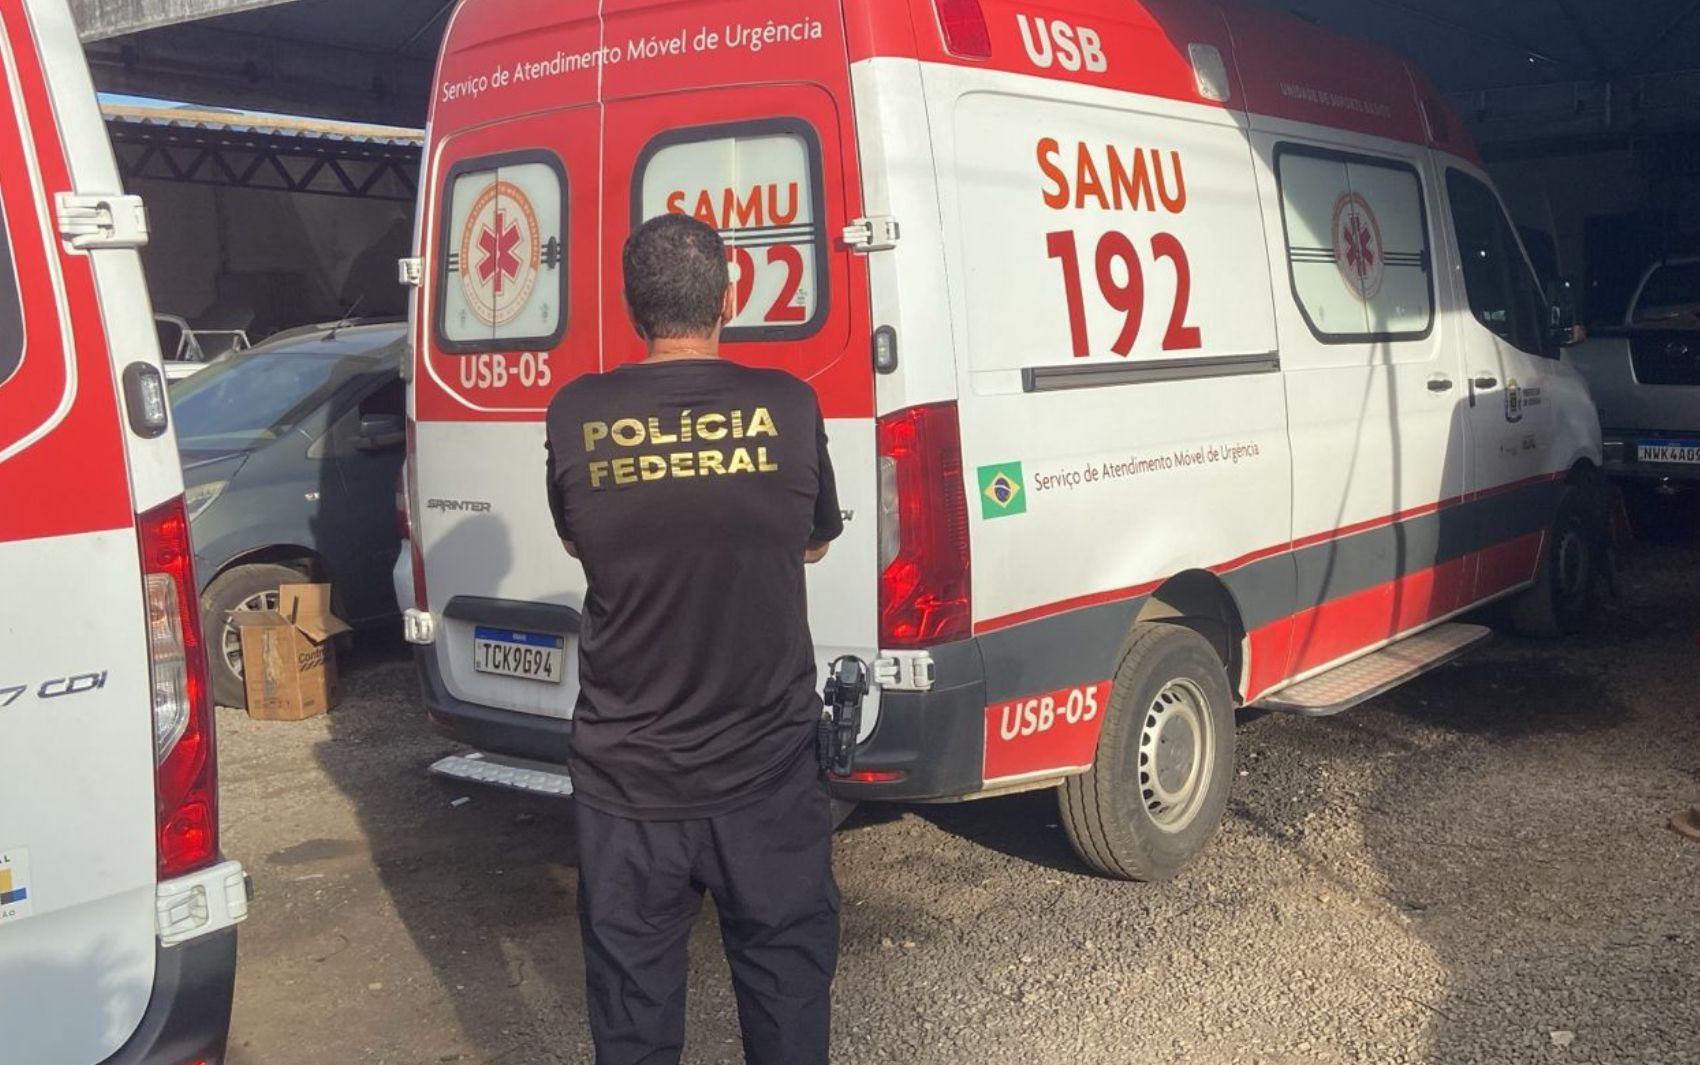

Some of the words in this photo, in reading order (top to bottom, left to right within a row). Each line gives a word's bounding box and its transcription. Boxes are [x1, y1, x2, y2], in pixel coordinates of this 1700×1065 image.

[442, 75, 488, 102] Serviço
[491, 66, 509, 88] de
[513, 47, 621, 83] Atendimento
[627, 29, 687, 61] Móvel
[693, 26, 719, 51] de
[725, 16, 822, 51] Urgência
[1015, 14, 1108, 73] USB
[1036, 137, 1187, 214] SAMU
[666, 182, 798, 230] SAMU
[1046, 229, 1203, 358] 192
[459, 352, 552, 389] USB-05
[582, 407, 779, 452] POLÍCIA
[588, 446, 779, 489] FEDERAL
[1034, 467, 1081, 492] Serviço
[1083, 463, 1099, 482] de
[1102, 455, 1173, 480] Atendimento
[1174, 447, 1205, 467] Móvel
[1206, 445, 1219, 463] de
[1220, 440, 1260, 465] Urgência
[427, 499, 491, 513] SPRINTER
[37, 670, 108, 699] CDI
[483, 643, 552, 678] TCK9G94
[1000, 686, 1098, 741] USB-05
